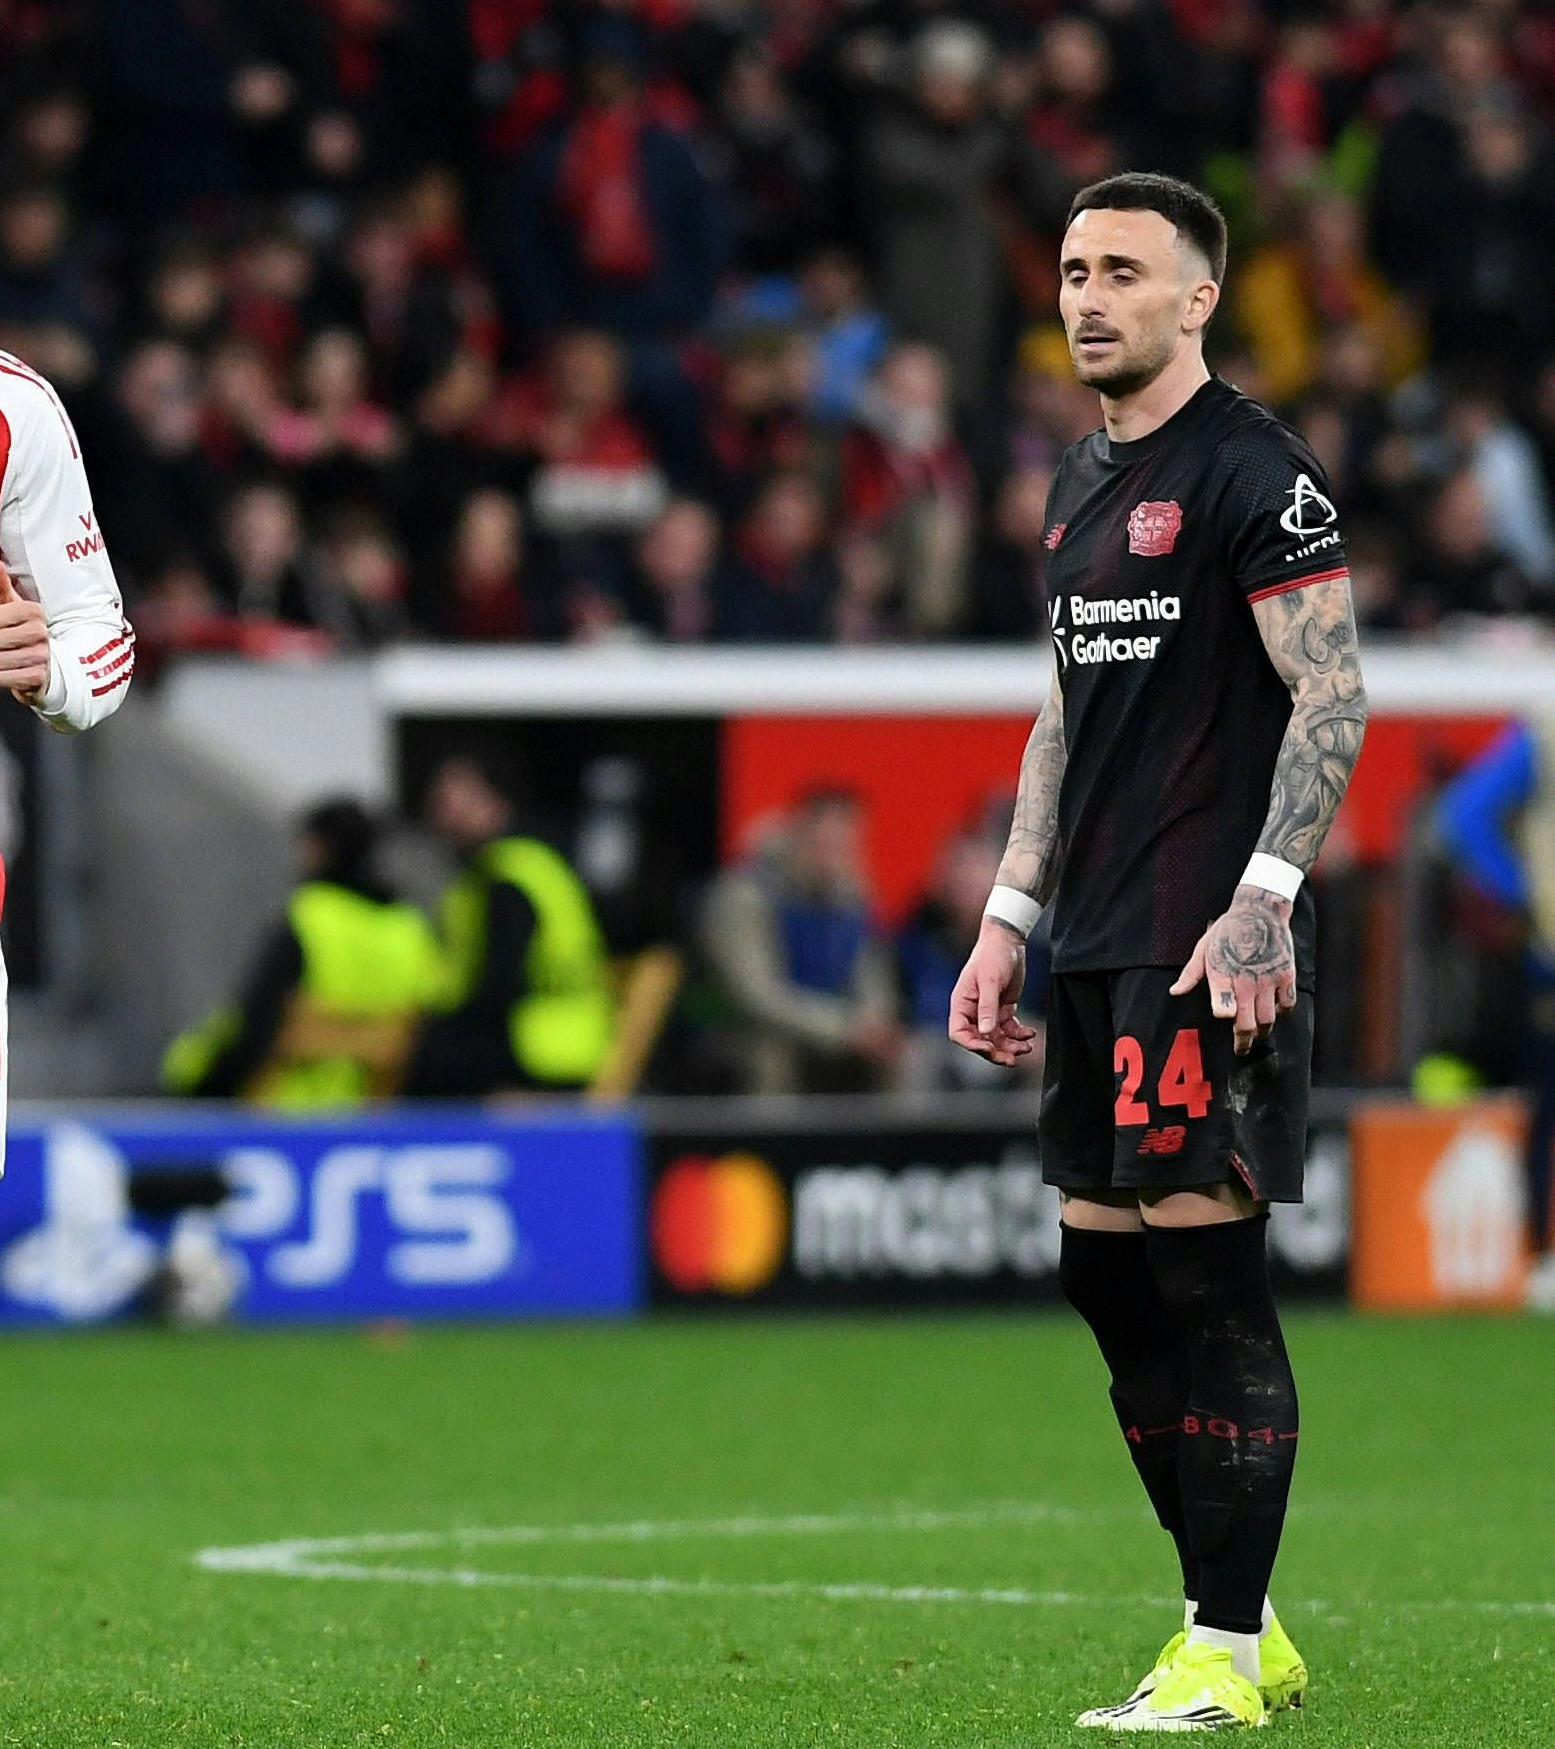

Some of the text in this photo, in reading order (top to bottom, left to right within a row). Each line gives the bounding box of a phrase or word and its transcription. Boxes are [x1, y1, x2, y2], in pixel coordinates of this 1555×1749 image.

[1070, 591, 1181, 625] Barmenia
[1071, 633, 1162, 666] Gothaer
[1114, 1028, 1214, 1126] 24
[217, 1144, 518, 1290] PS5
